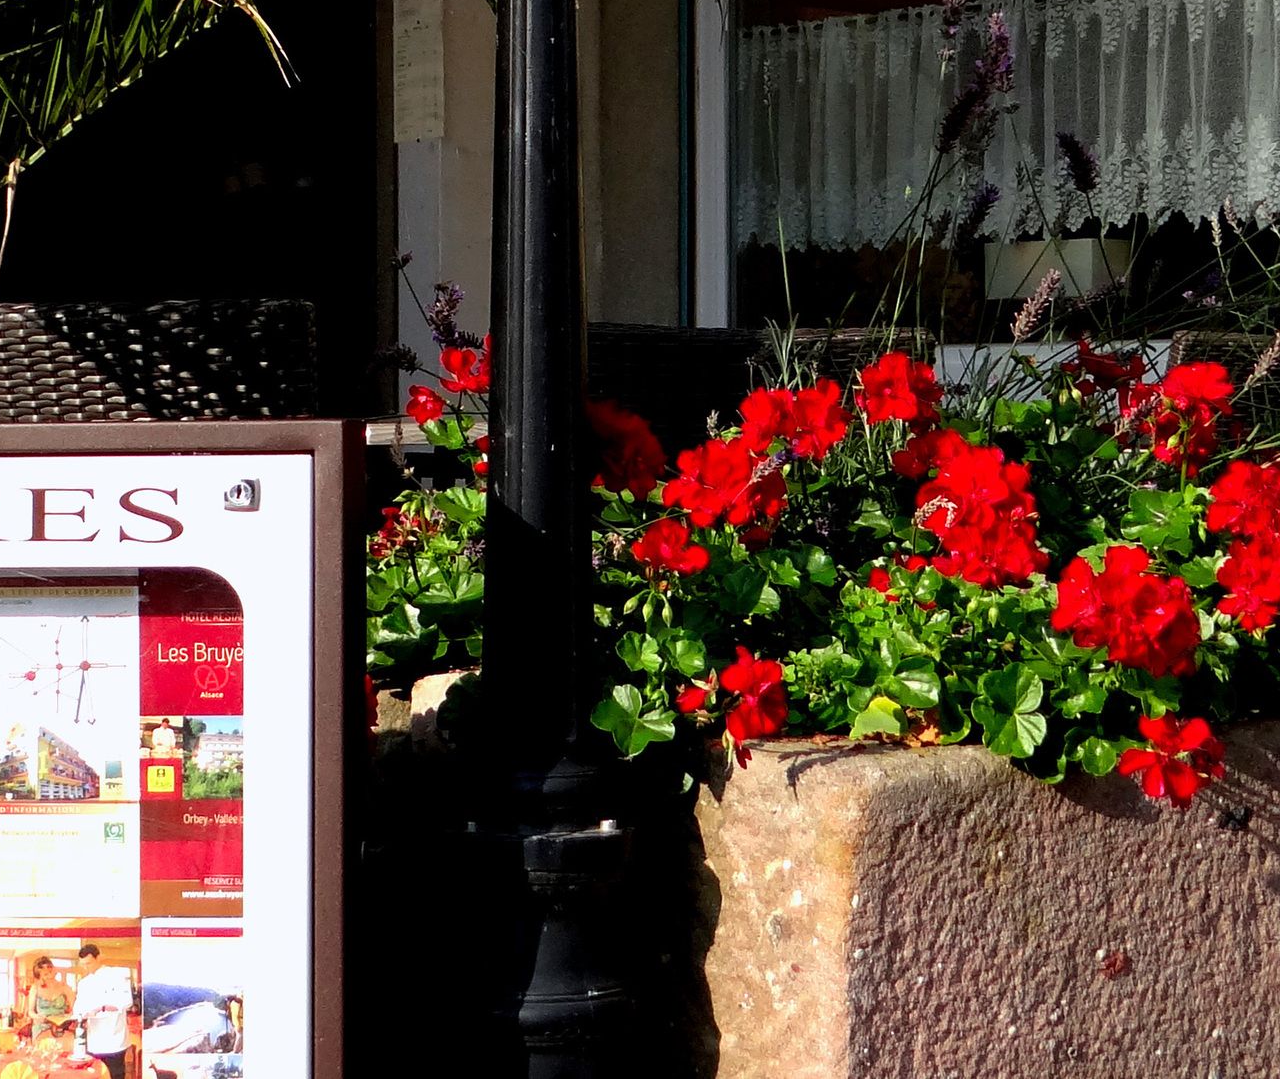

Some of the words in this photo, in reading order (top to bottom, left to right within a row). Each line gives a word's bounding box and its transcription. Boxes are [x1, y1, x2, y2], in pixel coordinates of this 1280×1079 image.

[157, 642, 189, 663] Les
[200, 691, 224, 699] Alsace
[183, 813, 208, 827] Orbey
[214, 813, 238, 825] Vallée
